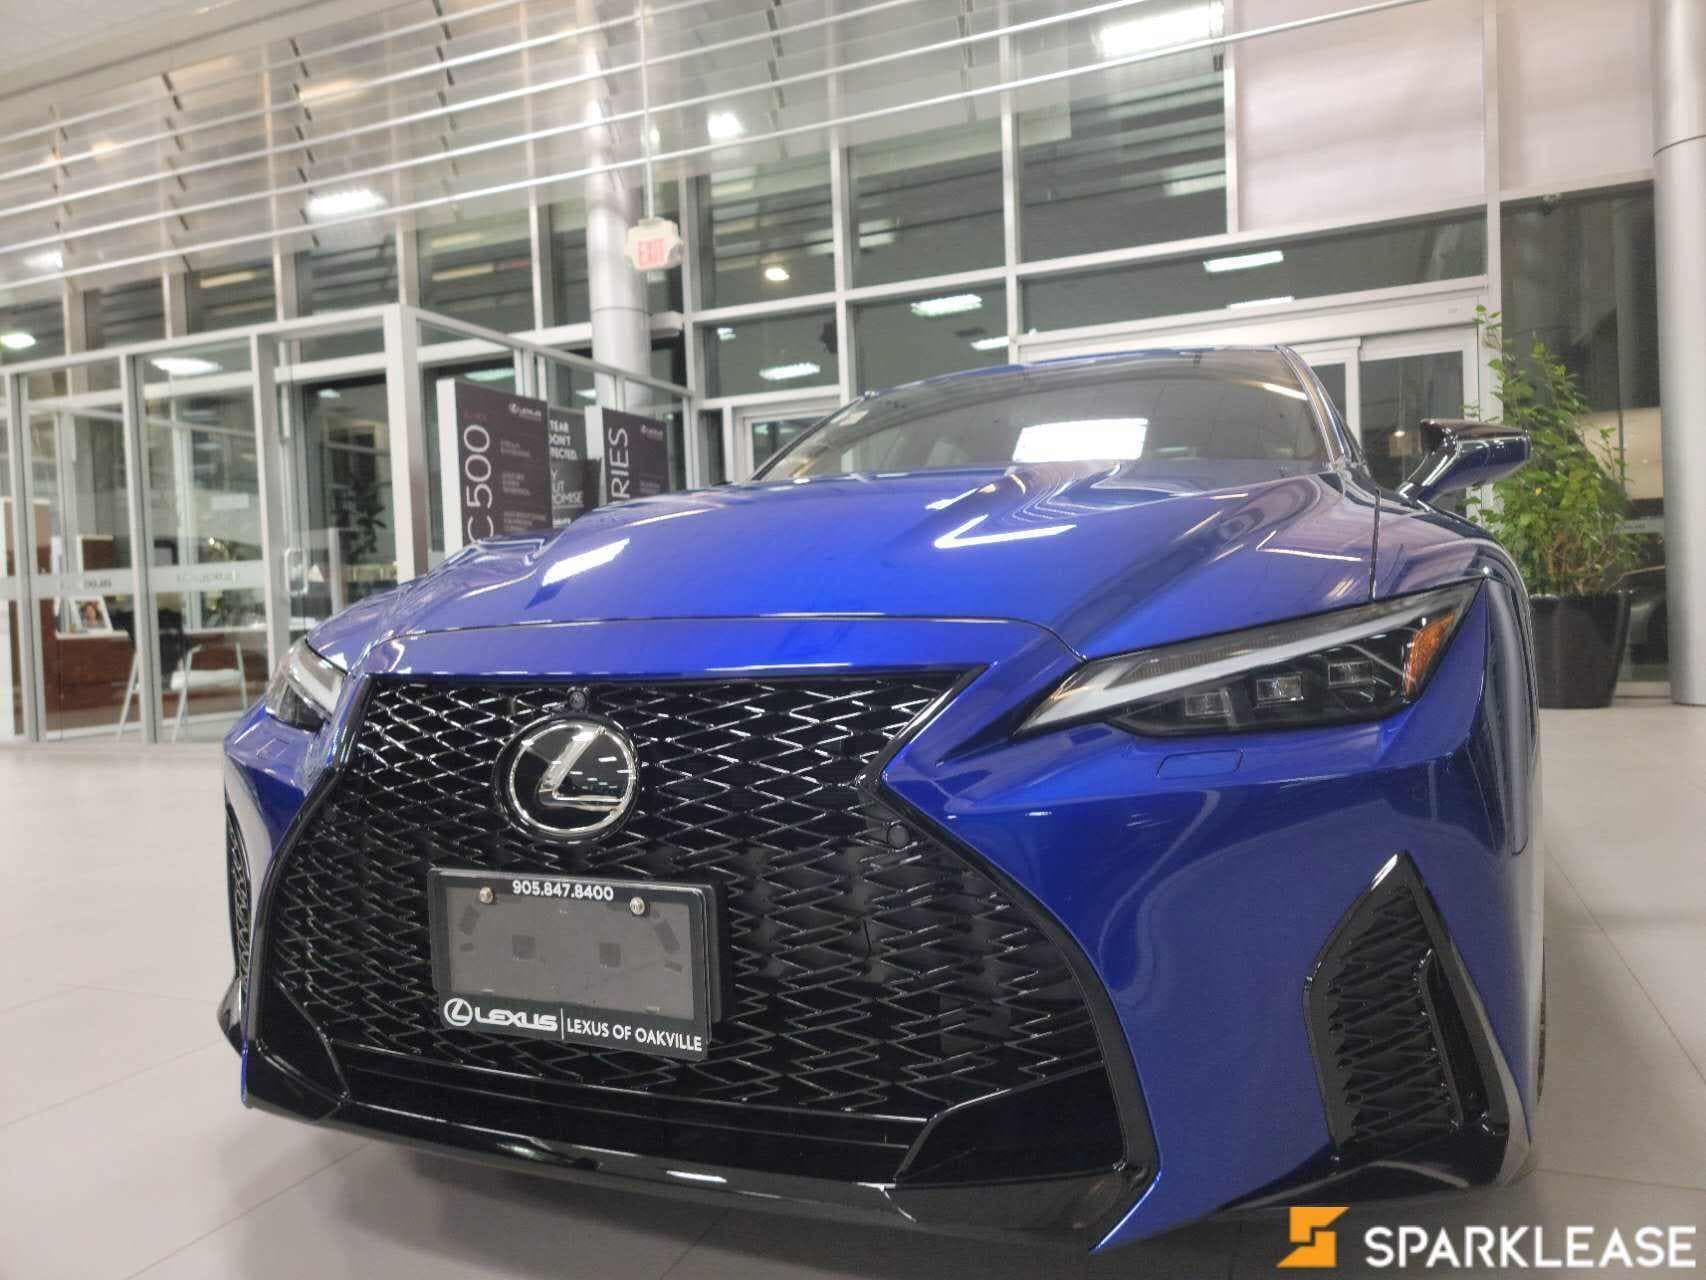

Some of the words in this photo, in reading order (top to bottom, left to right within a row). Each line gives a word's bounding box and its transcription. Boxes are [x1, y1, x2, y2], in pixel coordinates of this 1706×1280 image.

[463, 424, 493, 509] 500
[512, 880, 615, 902] 905.847.8400
[474, 1006, 559, 1032] LEXUS
[567, 1017, 609, 1039] LEXUS
[613, 1023, 632, 1041] OF
[635, 1027, 703, 1053] OAKVILLE
